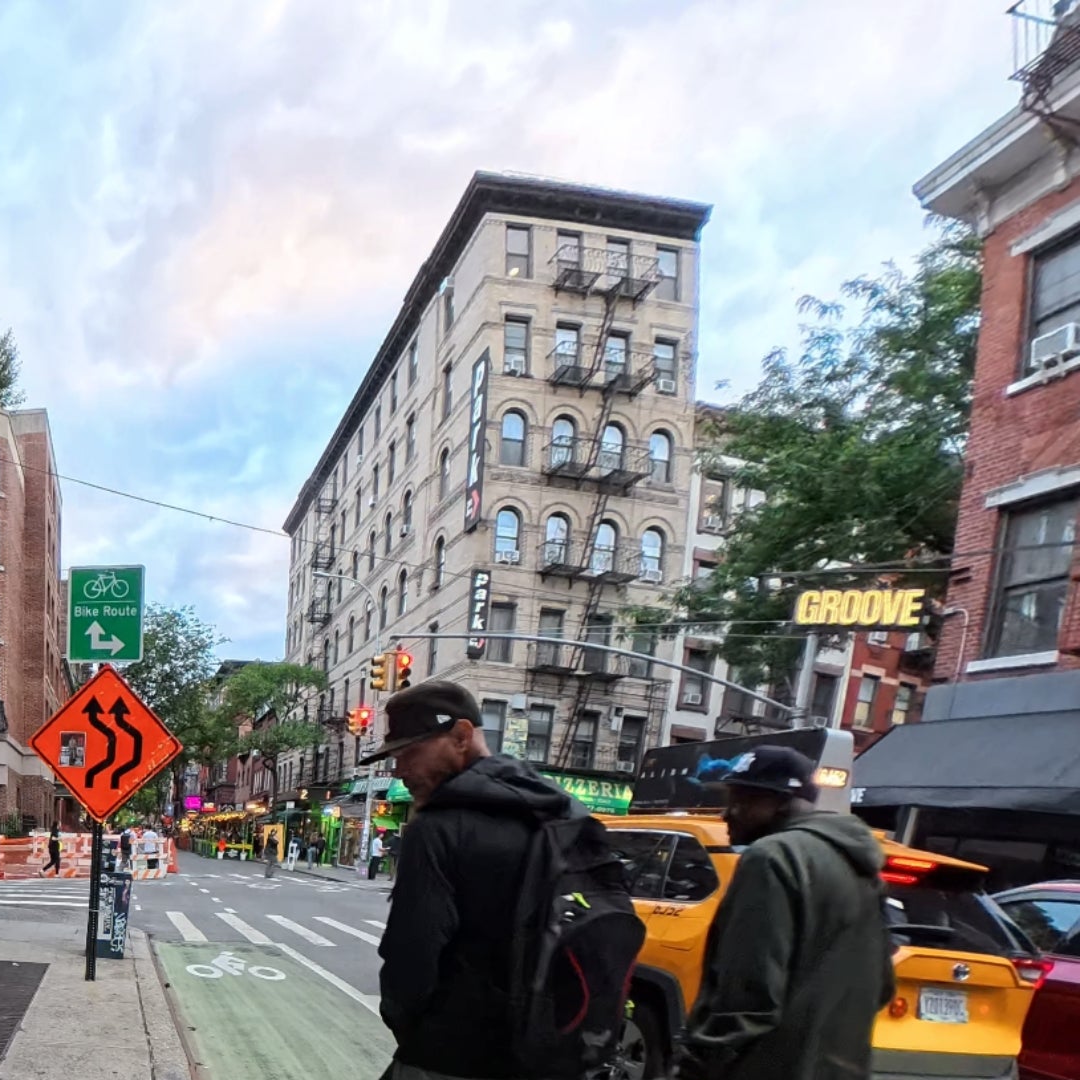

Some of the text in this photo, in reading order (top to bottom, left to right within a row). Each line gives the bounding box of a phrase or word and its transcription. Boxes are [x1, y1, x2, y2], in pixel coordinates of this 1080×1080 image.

[468, 360, 485, 488] Park
[74, 604, 138, 617] Bike Route
[471, 572, 489, 630] Park
[795, 588, 925, 625] GROOVE
